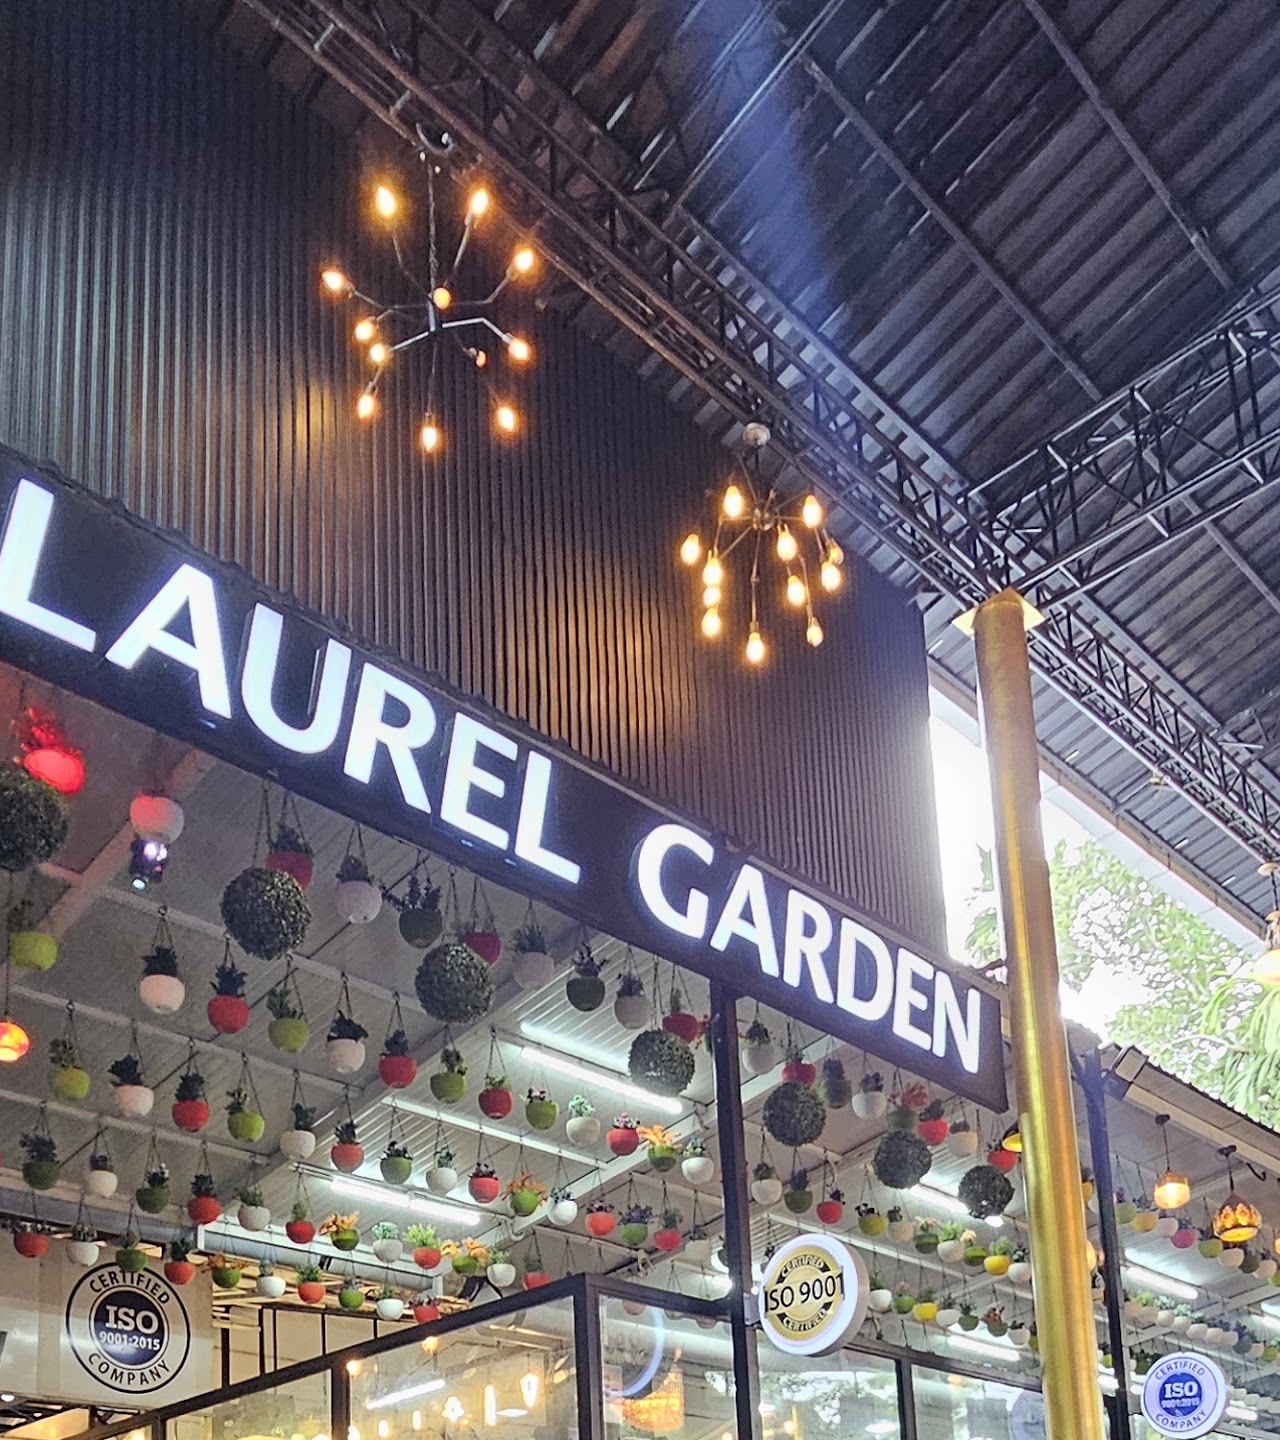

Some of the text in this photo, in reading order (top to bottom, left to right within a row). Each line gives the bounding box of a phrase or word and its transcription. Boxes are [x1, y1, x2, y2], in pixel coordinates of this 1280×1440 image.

[635, 823, 982, 1075] GARDEN
[781, 1254, 825, 1278] CERTIFIED
[89, 1271, 170, 1305] CERTIFIED
[764, 1273, 845, 1312] ISO 9001
[105, 1305, 159, 1334] ISO
[99, 1331, 161, 1351] 9001:2015
[88, 1358, 170, 1386] COMPANY
[1154, 1361, 1205, 1380] CERTIFIED
[1164, 1381, 1198, 1398] ISO
[1155, 1409, 1206, 1429] COMPANY
